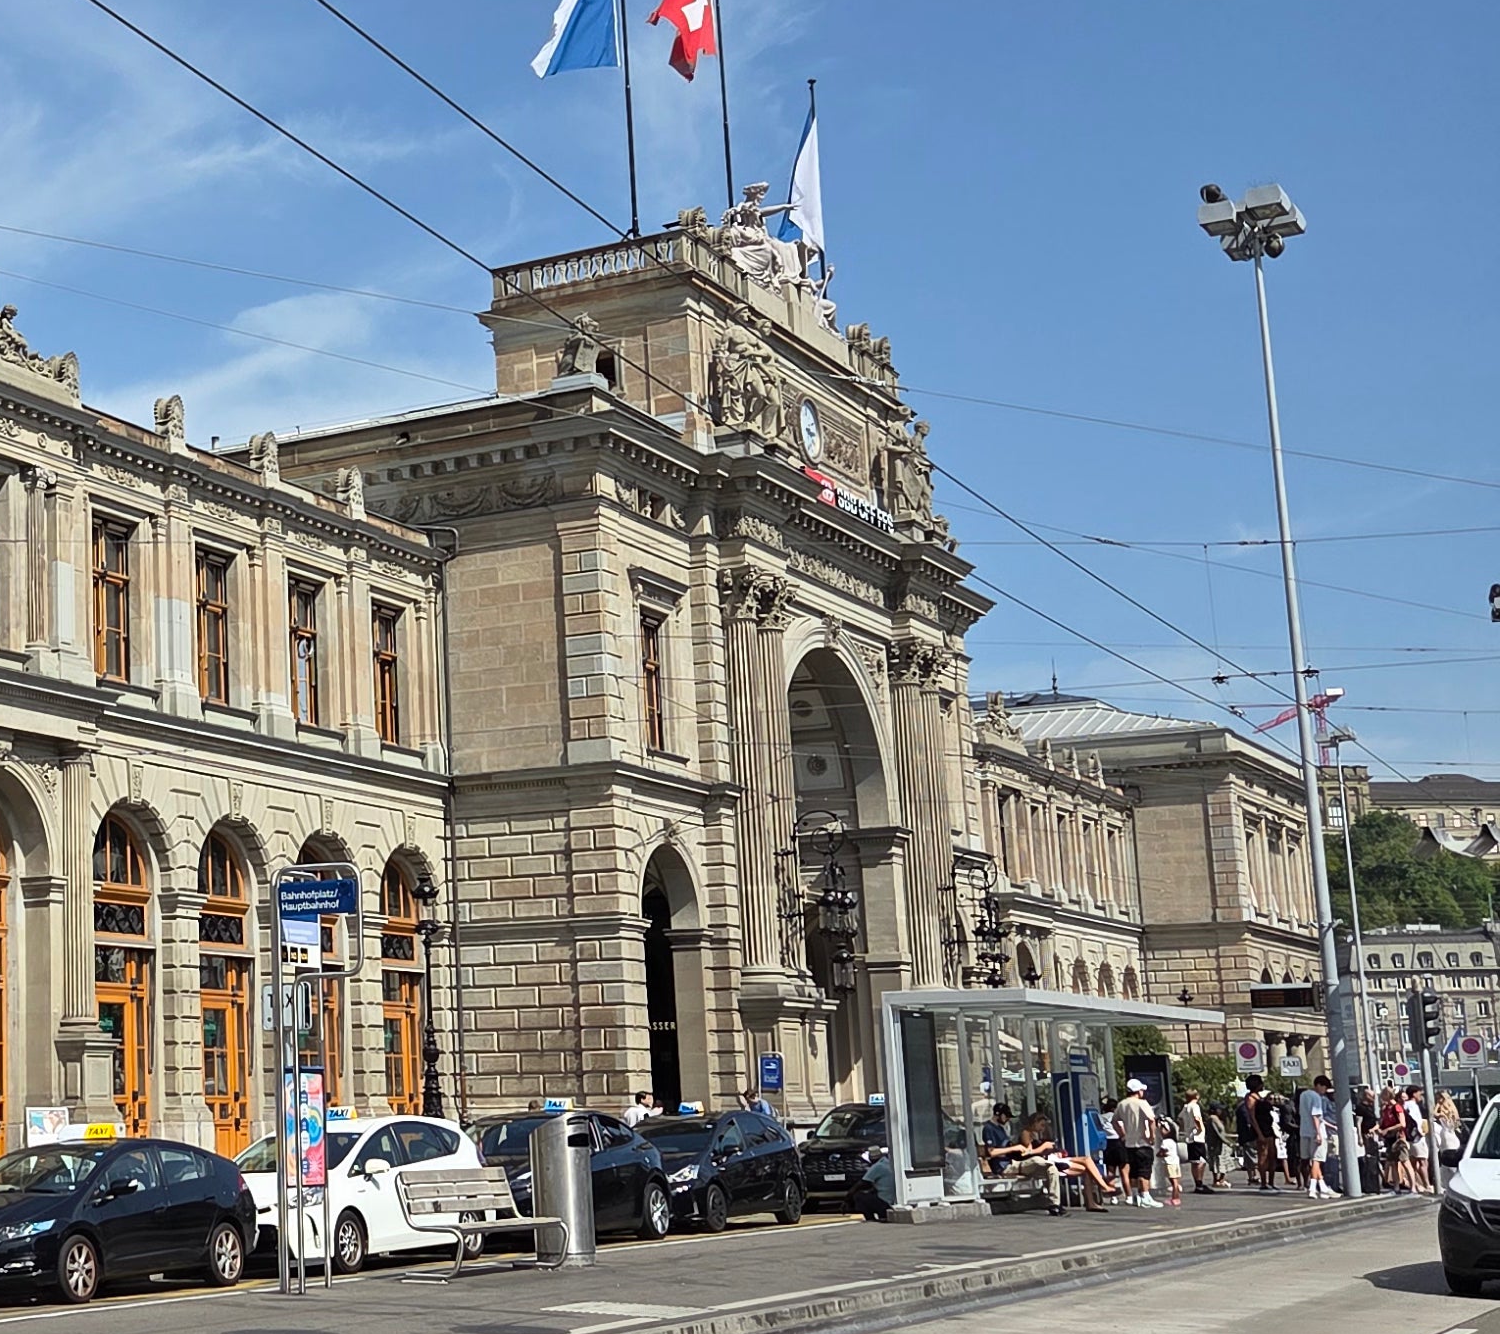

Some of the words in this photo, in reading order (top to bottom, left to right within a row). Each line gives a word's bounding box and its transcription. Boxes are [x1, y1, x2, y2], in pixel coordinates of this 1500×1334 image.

[281, 888, 338, 900] Bahnhofplatz/
[281, 899, 339, 912] Hauptbahnhof
[649, 1021, 676, 1031] SSER
[328, 1108, 349, 1118] TAXI
[88, 1127, 109, 1136] TAXI
